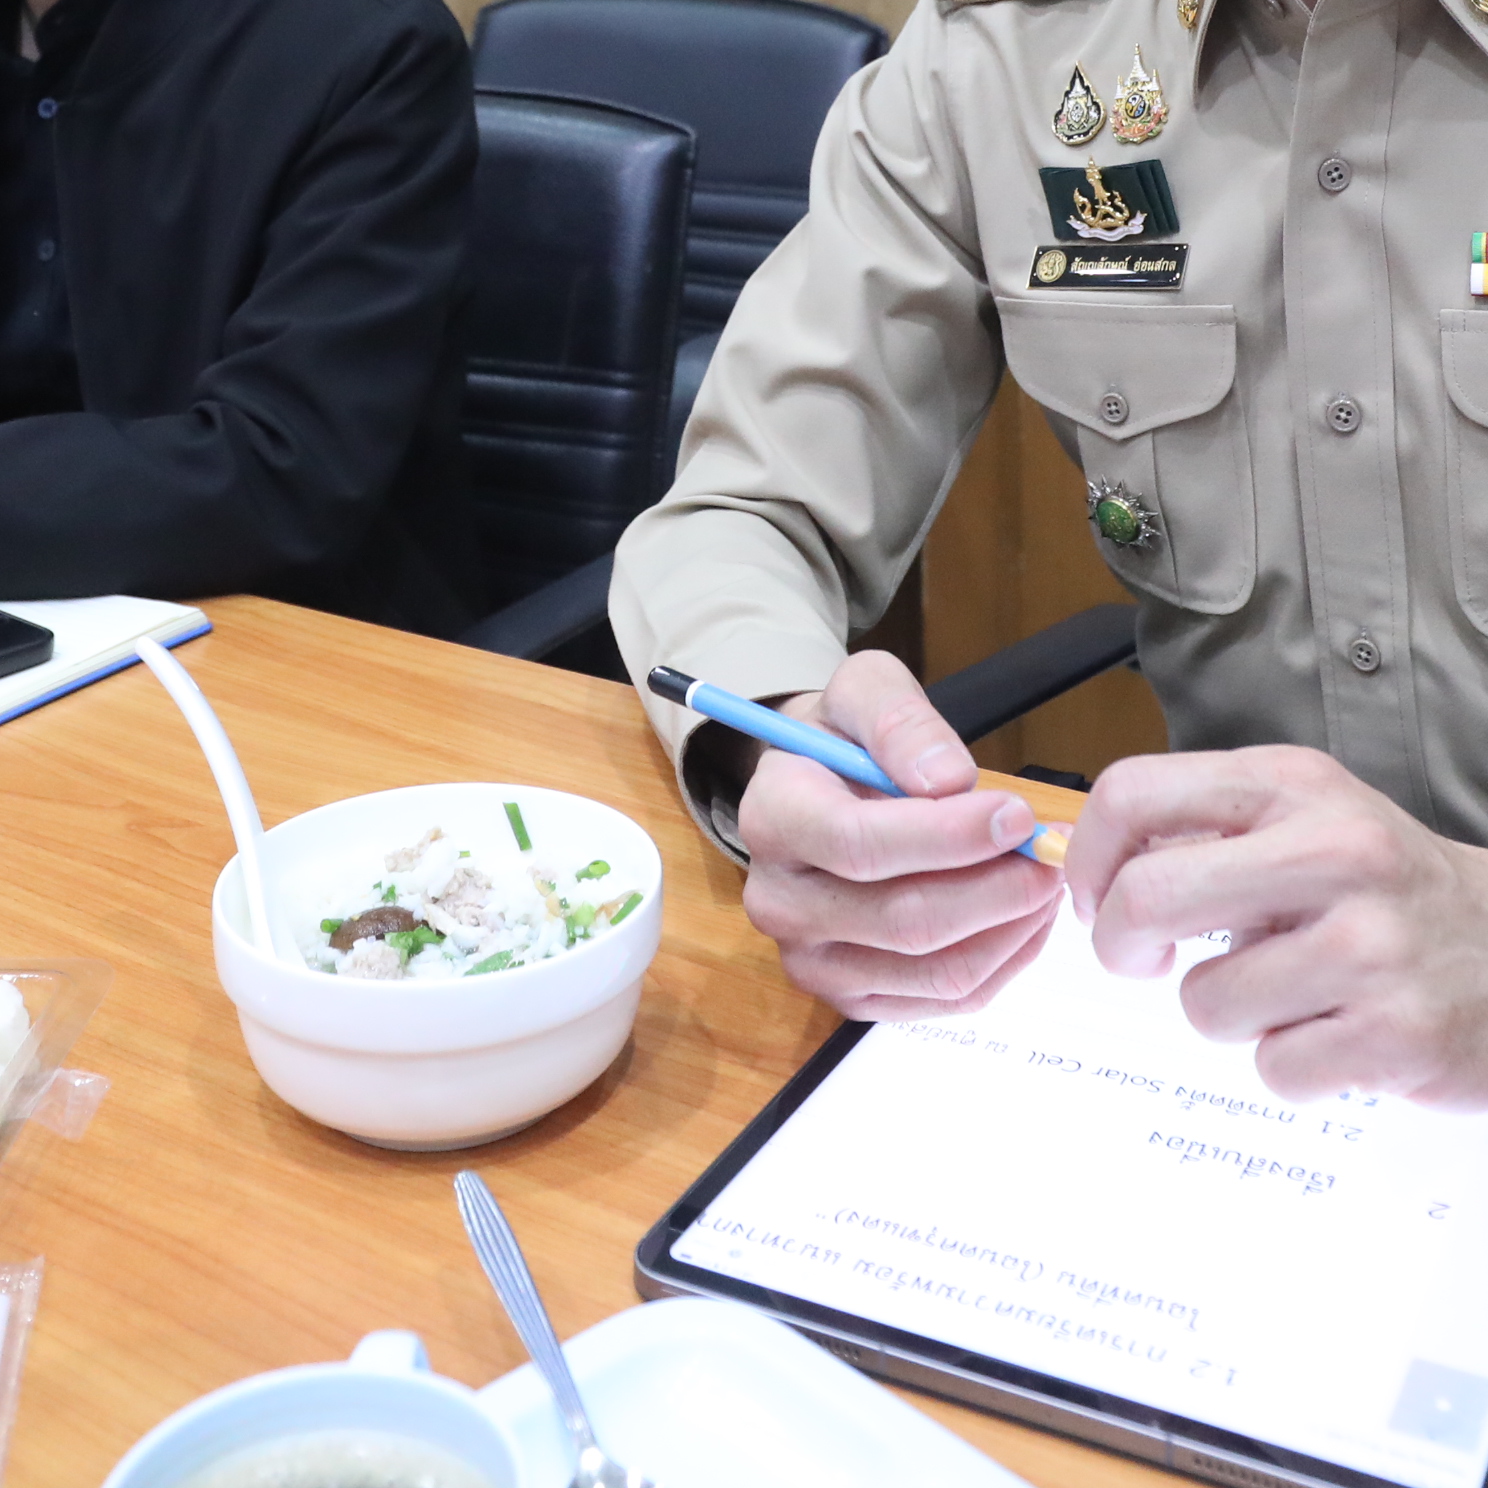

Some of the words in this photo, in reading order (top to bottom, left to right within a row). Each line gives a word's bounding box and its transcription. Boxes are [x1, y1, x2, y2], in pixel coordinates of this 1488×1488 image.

[985, 1040, 1009, 1053] ณ
[1028, 1051, 1083, 1073] Cell
[1092, 1067, 1166, 1094] Solar
[1175, 1086, 1297, 1124] การติดตั้ง
[1323, 1122, 1363, 1142] 2.1
[1428, 1203, 1452, 1221] 2
[854, 1259, 1168, 1360] การเตรียมความพร้อม
[1058, 1271, 1200, 1330] โฉนดที่ดิน
[1190, 1360, 1238, 1386] 1.2
